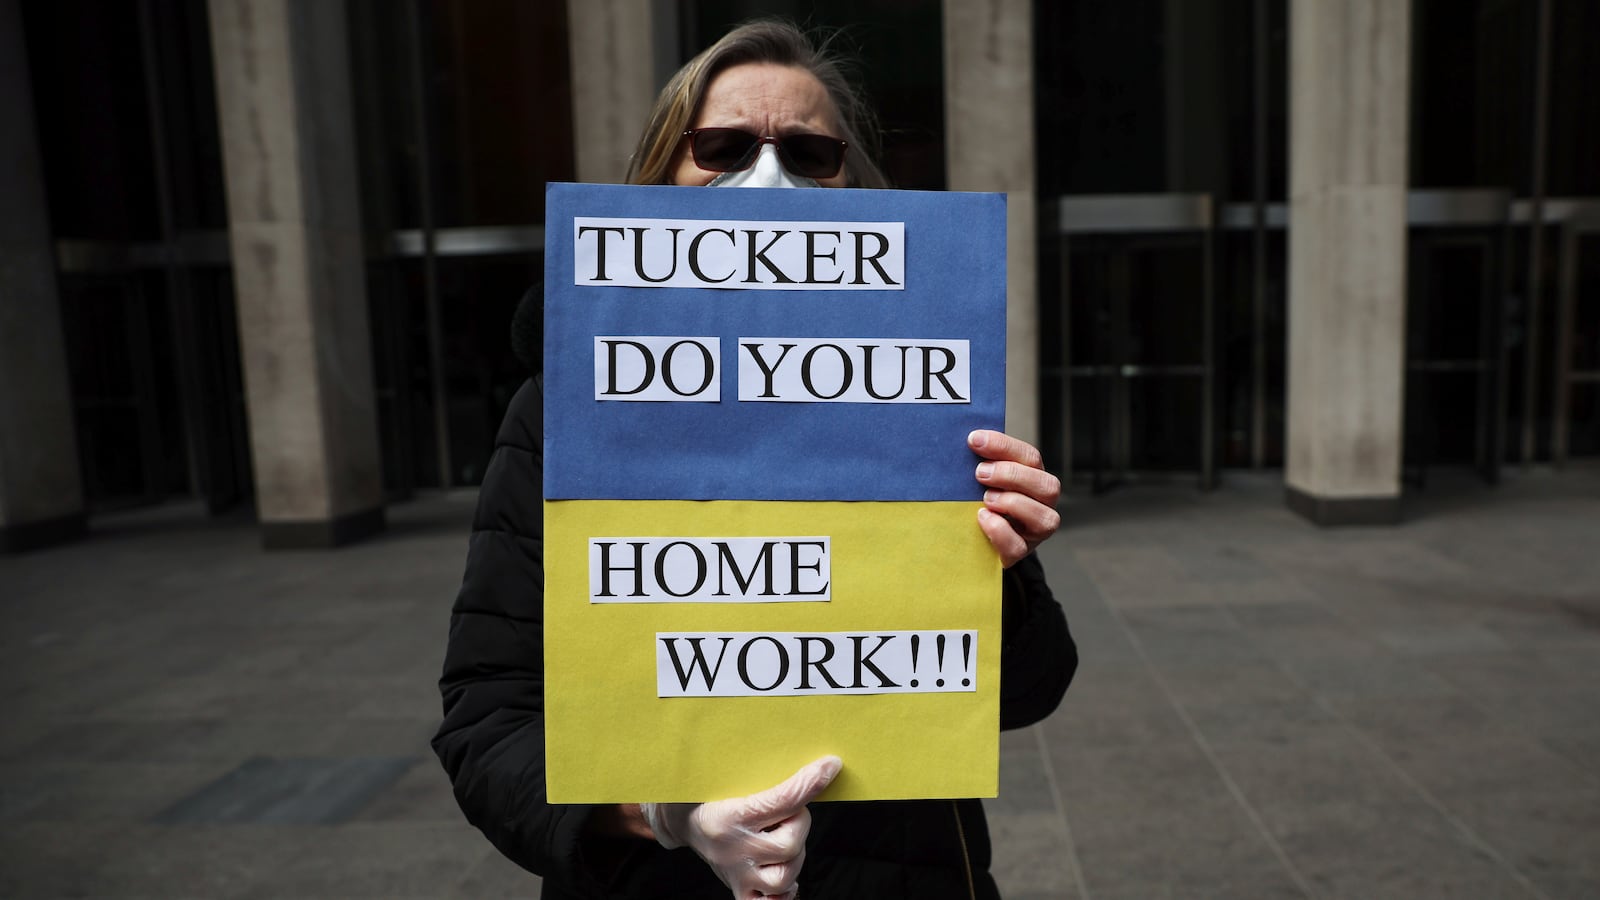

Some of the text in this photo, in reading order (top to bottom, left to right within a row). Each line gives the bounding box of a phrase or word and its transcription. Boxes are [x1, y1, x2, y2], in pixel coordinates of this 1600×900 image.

[578, 226, 900, 285] TUCKER
[600, 340, 966, 401] DO YOUR
[593, 541, 829, 598] HOME
[660, 633, 972, 692] WORK!!!
